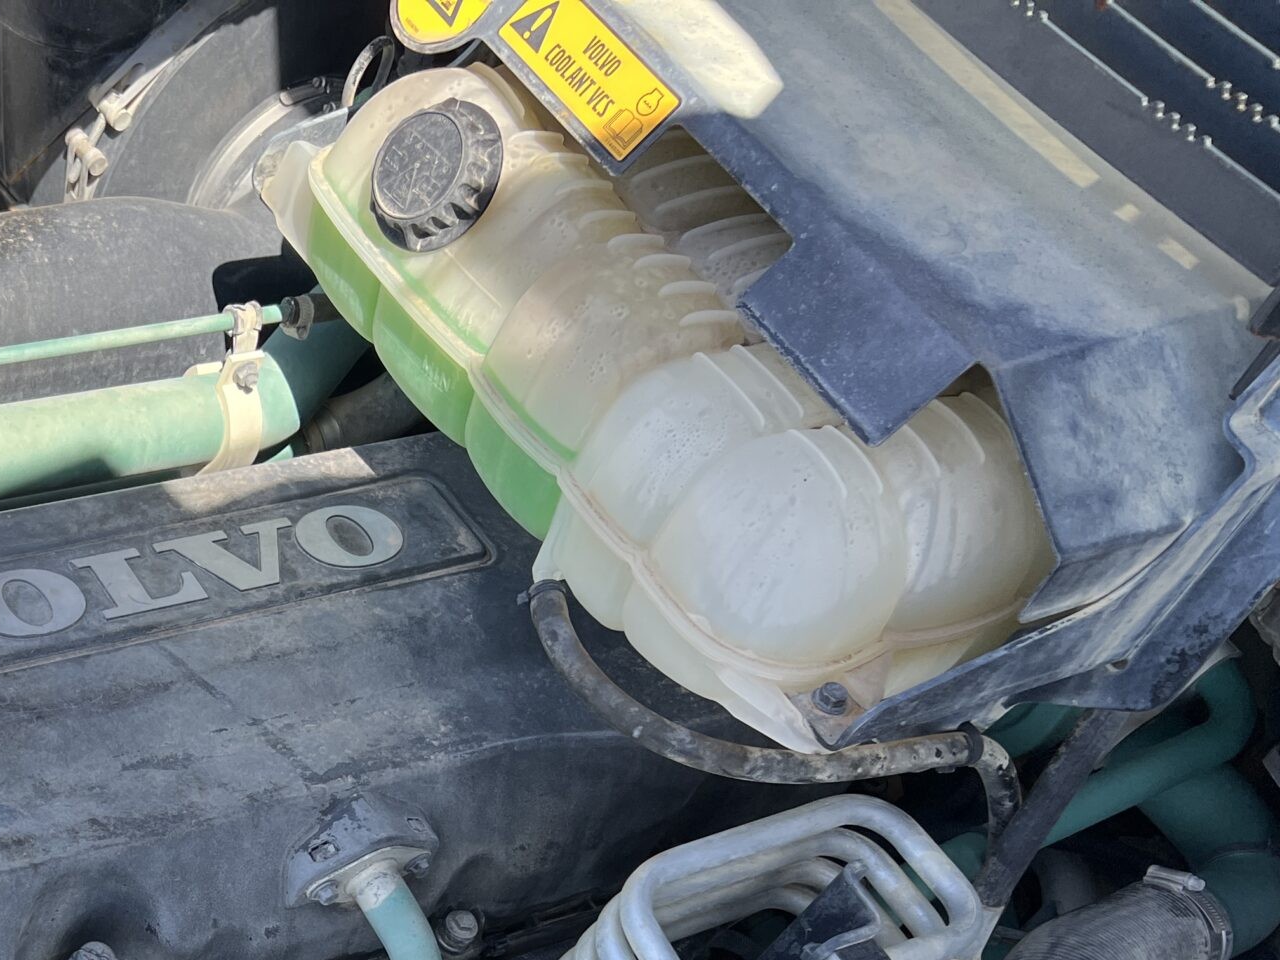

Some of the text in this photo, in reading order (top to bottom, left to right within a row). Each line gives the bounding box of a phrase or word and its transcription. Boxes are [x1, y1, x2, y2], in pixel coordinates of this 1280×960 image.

[544, 43, 616, 118] COOLANT VCS
[582, 35, 622, 77] VOLVO
